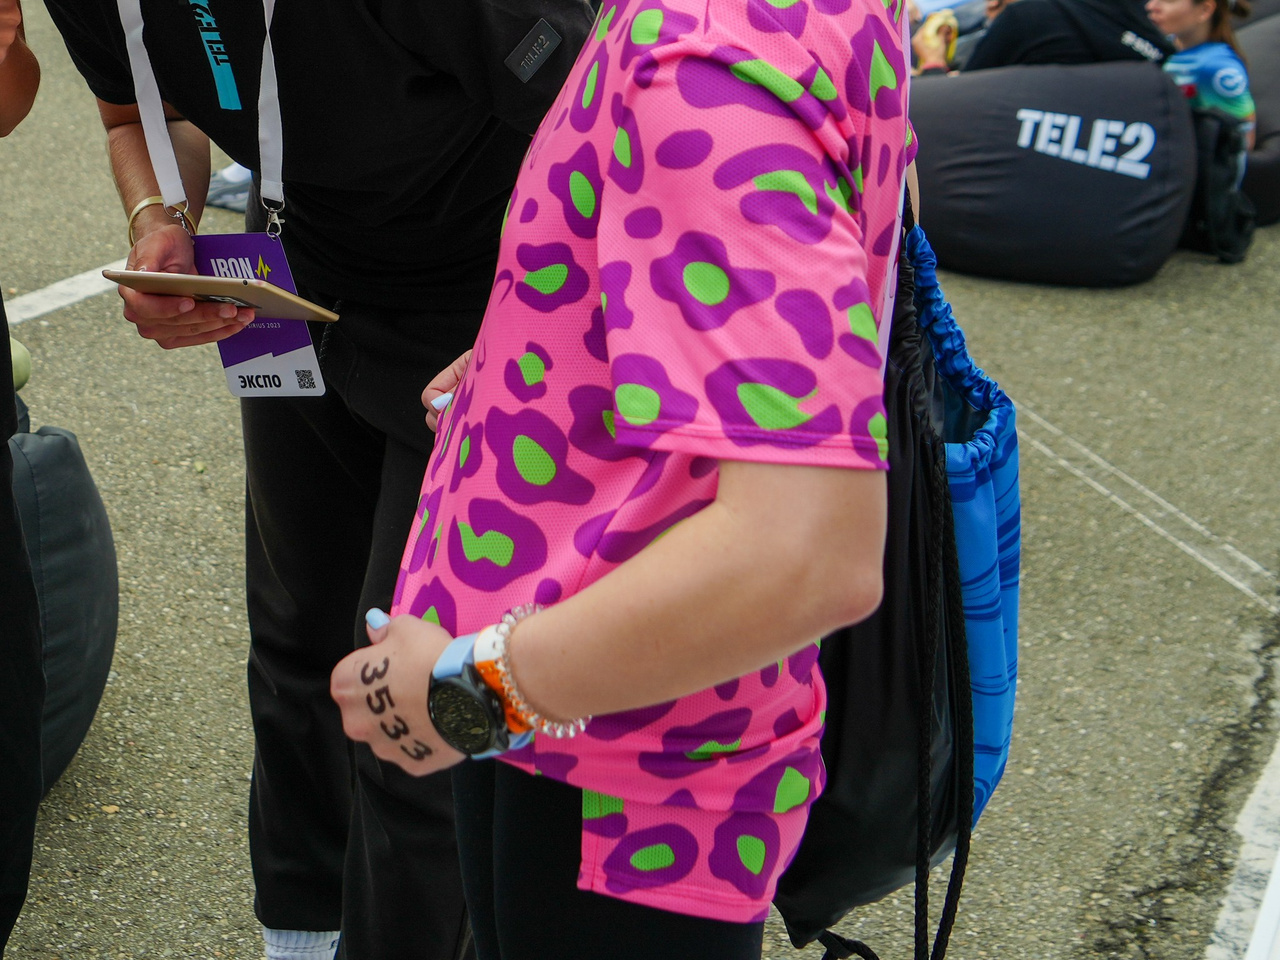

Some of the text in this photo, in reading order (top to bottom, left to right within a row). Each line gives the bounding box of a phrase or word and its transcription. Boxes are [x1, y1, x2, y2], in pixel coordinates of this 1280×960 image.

[520, 34, 550, 69] TELE2
[1016, 107, 1157, 180] TELE2
[210, 257, 256, 280] IRON
[238, 374, 282, 389] ЭКСПО
[360, 656, 433, 762] 3533
